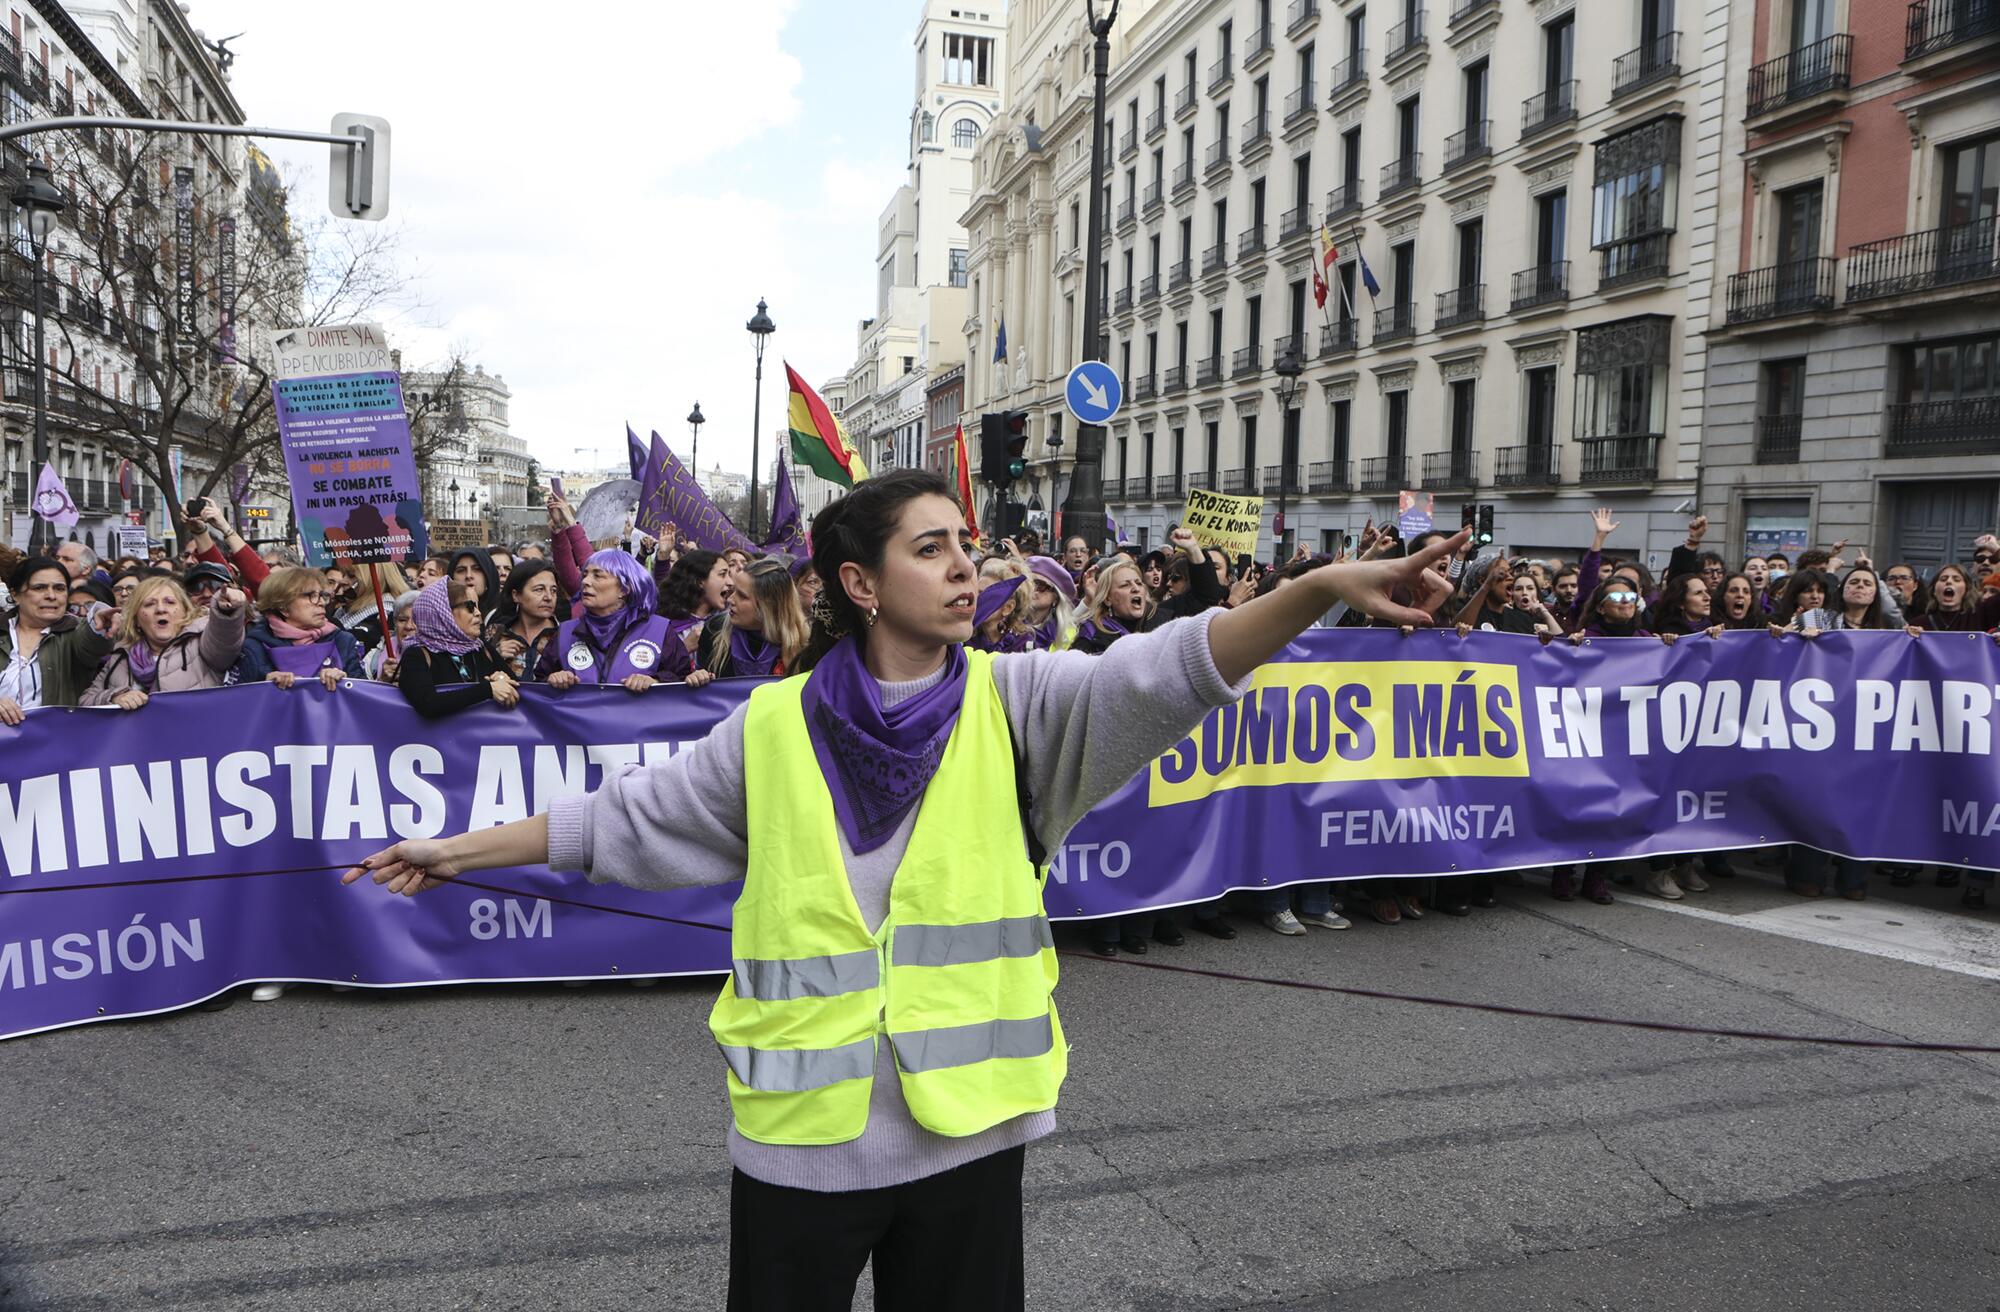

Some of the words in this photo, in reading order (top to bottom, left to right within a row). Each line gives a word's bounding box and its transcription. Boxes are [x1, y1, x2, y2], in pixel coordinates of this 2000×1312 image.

[180, 281, 192, 303] SER
[307, 330, 348, 347] DIMITE
[350, 326, 375, 347] YA
[302, 349, 387, 373] ENCUBRIDOR
[280, 386, 289, 394] EN
[292, 382, 333, 392] MÓSTOLES
[337, 380, 347, 388] NO
[364, 378, 395, 387] CAMBIA
[339, 391, 349, 399] DE
[285, 404, 300, 413] POR
[325, 417, 351, 425] VIOLENCIA
[353, 415, 373, 423] CONTRA
[312, 429, 338, 437] RECURSOS
[298, 453, 309, 462] LA
[312, 450, 352, 461] VIOLENCIA
[358, 447, 400, 458] MACHISTA
[309, 463, 325, 474] NO
[330, 461, 344, 473] SE
[348, 457, 391, 472] BORRA
[313, 480, 328, 493] SE
[333, 475, 393, 491] COMBATE
[323, 497, 336, 508] UN
[340, 495, 365, 507] PASO
[369, 490, 407, 505] ATRÁS!
[1188, 490, 1241, 515] PROTEGE
[1188, 512, 1206, 526] EN
[1207, 516, 1223, 530] EL
[313, 540, 323, 549] En
[324, 538, 362, 548] Móstoles
[374, 534, 415, 544] NOMBRA,
[331, 549, 362, 559] LUCHA,
[374, 546, 414, 556] PROTEGE.
[1160, 682, 1376, 784] SOMOS
[1392, 670, 1518, 759] MÁS
[1534, 686, 1603, 758] EN
[1620, 678, 1836, 755] TODAS
[1854, 679, 2000, 755] PAR
[469, 898, 553, 941] 8M
[1320, 804, 1516, 848] FEMINISTA
[1677, 790, 1728, 823] DE
